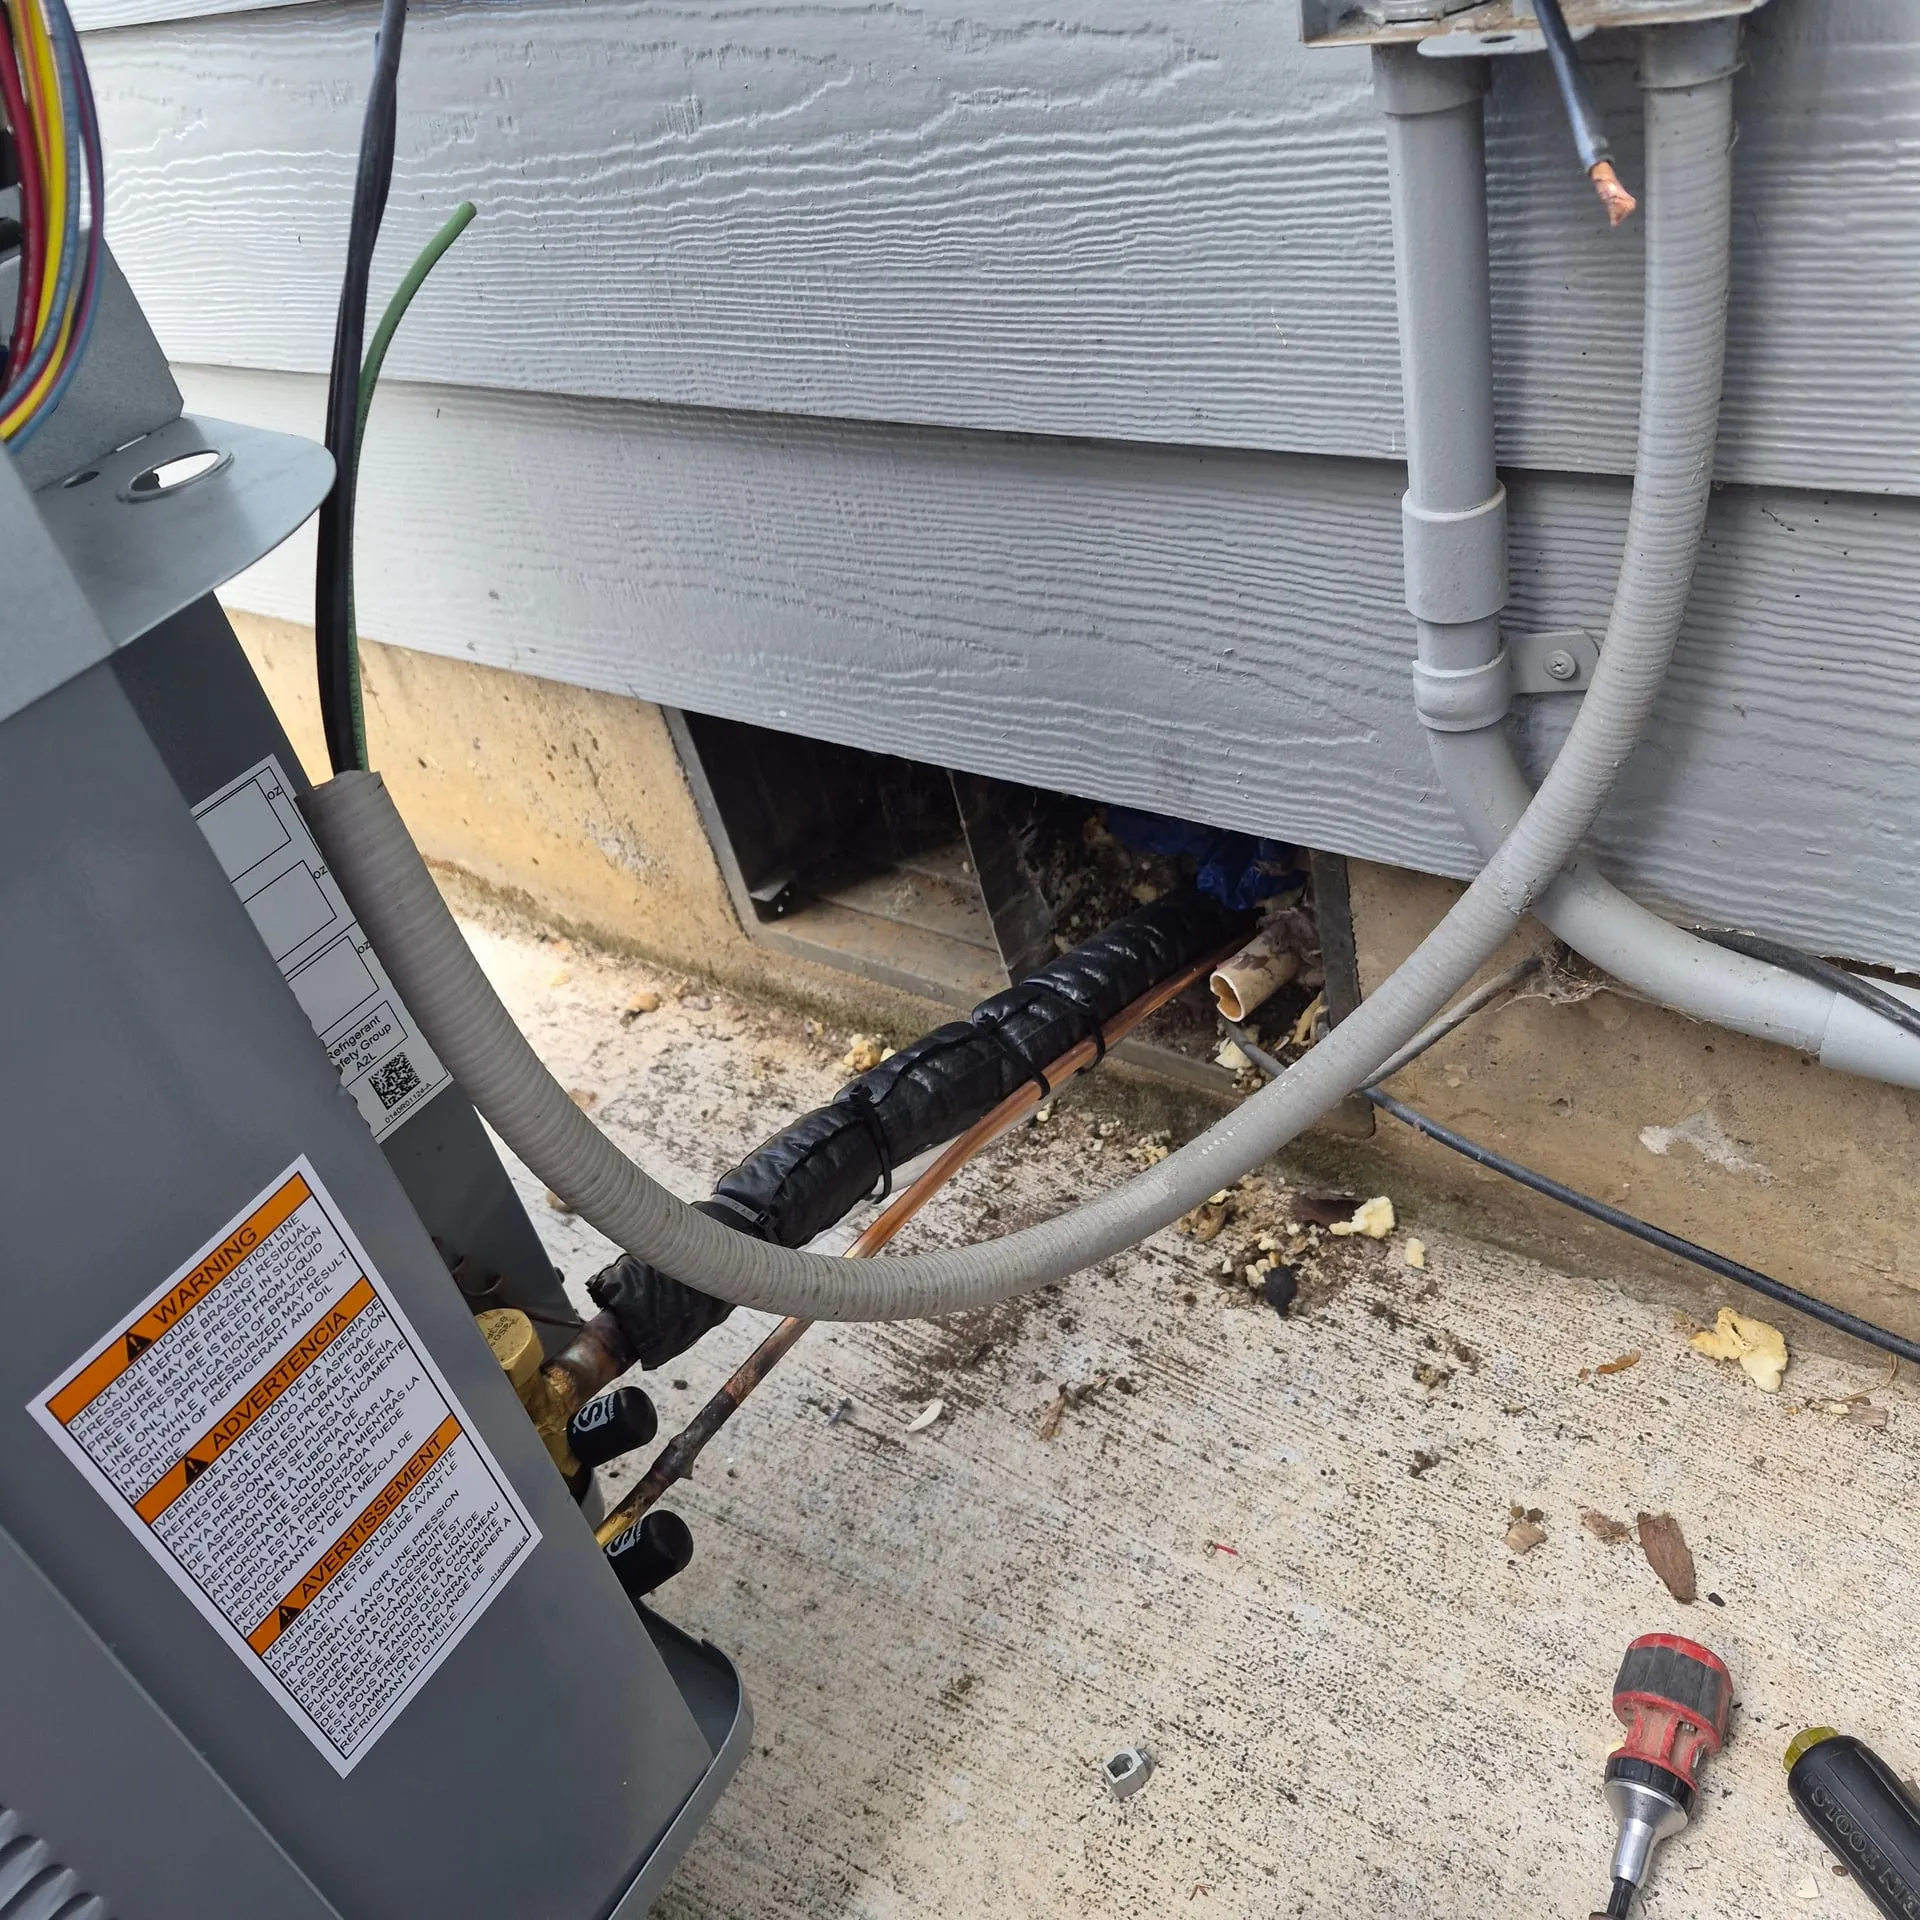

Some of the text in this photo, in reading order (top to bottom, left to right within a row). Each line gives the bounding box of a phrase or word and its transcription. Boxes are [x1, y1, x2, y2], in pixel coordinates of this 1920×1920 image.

[267, 786, 282, 800] OZ
[314, 866, 328, 879] OZ
[356, 1053, 377, 1071] A2L
[360, 1024, 391, 1050] Group
[67, 1213, 300, 1433] CHECK BOTH LIQUID AND SUCTION LINE
[76, 1373, 149, 1443] PRESSURE
[147, 1325, 200, 1378] BEFORE
[253, 1219, 311, 1276] RESIDUAL
[85, 1225, 323, 1454] PRESSURE MAY BE PRESENT IN SUCTION
[94, 1240, 324, 1464] LINE IF PRESSURE IS BLED FROM LIQUID
[151, 1224, 259, 1328] WARNING
[102, 1441, 135, 1474] LINE
[170, 1330, 251, 1409] APPLICATION
[248, 1312, 268, 1334] OF
[266, 1264, 318, 1316] BRAZING
[110, 1248, 349, 1484] TORCH WHILE PRESSURIZED MAY RESULT
[119, 1281, 333, 1493] IN IGNITION OF REFRIGERANT AND OIL
[169, 1507, 212, 1553] ANTES
[210, 1489, 230, 1511] DE
[278, 1420, 297, 1441] ES
[295, 1361, 354, 1424] PROBABLE
[351, 1337, 377, 1366] QUE
[206, 1307, 349, 1452] ADVERTENCIA
[160, 1448, 253, 1543] REFRIGERANTE
[297, 1391, 309, 1405] Y
[306, 1374, 325, 1395] DE
[177, 1524, 213, 1562] HAYA
[262, 1415, 319, 1476] RESIDUAL
[317, 1398, 335, 1419] EN
[333, 1382, 350, 1402] LA
[185, 1549, 206, 1571] DE
[273, 1465, 288, 1482] SI
[286, 1447, 305, 1468] SE
[302, 1406, 343, 1451] PURGA
[193, 1560, 212, 1580] LA
[261, 1489, 281, 1511] DE
[279, 1472, 297, 1493] LA
[340, 1406, 359, 1427] DE
[201, 1496, 290, 1591] REFRIGERANTE
[334, 1400, 381, 1451] APLICAR
[378, 1384, 394, 1404] LA
[209, 1372, 420, 1600] ANTORCHA DE SOLDADURA MIENTRAS LA
[224, 1546, 290, 1618] PROVOCAR
[287, 1531, 306, 1551] LA
[350, 1457, 374, 1483] DEL
[233, 1429, 413, 1627] REFRIGERANTE Y DE LA MEZCLA DE
[296, 1443, 371, 1525] PRESURIZADA
[368, 1406, 404, 1447] PUEDE
[297, 1434, 445, 1601] AVERTISSEMENT
[311, 1590, 329, 1611] LA
[326, 1533, 380, 1595] PRESSION
[378, 1516, 395, 1537] DE
[393, 1500, 409, 1520] LA
[406, 1446, 457, 1504] CONDUITE
[271, 1459, 458, 1673] D'ASPIRATION ET DE LIQUIDE AVANT LE
[285, 1488, 460, 1688] IL POURRAIT Y AVOIR UNE PRESSION
[299, 1515, 462, 1706] D'ASPIRATION SI LA PRESSION EST
[319, 1516, 499, 1729] DE BRASAGE TANDIS QUE LA CONDUITE
[349, 1642, 366, 1663] DE
[364, 1626, 381, 1646] LA
[378, 1569, 429, 1630] CONDUITE
[427, 1552, 444, 1572] DE
[441, 1509, 480, 1555] LIQUIDE
[375, 1582, 431, 1649] APPLIQUER
[429, 1565, 446, 1585] UN
[443, 1500, 500, 1568] CHALUMEAU
[407, 1652, 422, 1672] ET
[1811, 1786, 1881, 1872] TOOLS
